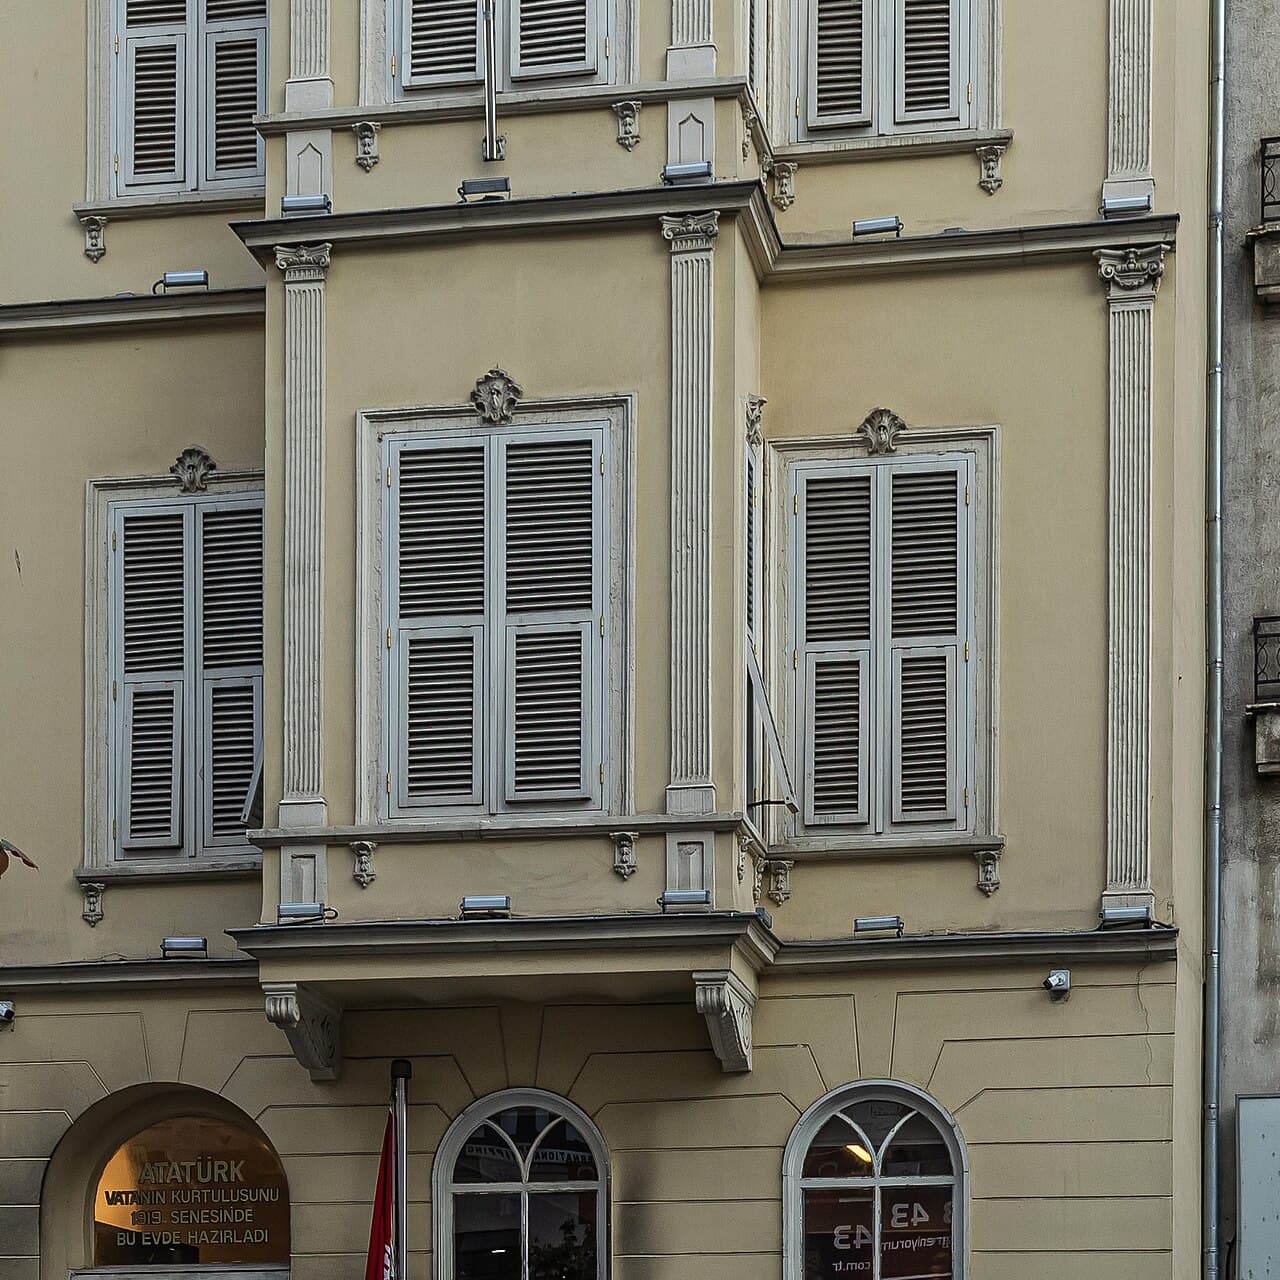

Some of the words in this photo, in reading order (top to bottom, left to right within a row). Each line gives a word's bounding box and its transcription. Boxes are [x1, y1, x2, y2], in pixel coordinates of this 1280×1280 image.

[139, 1156, 246, 1185] ATATÜRK
[104, 1189, 167, 1206] VATANIN
[116, 1231, 136, 1247] BU
[141, 1231, 181, 1246] EVDE
[187, 1228, 269, 1245] HAZIRLADI
